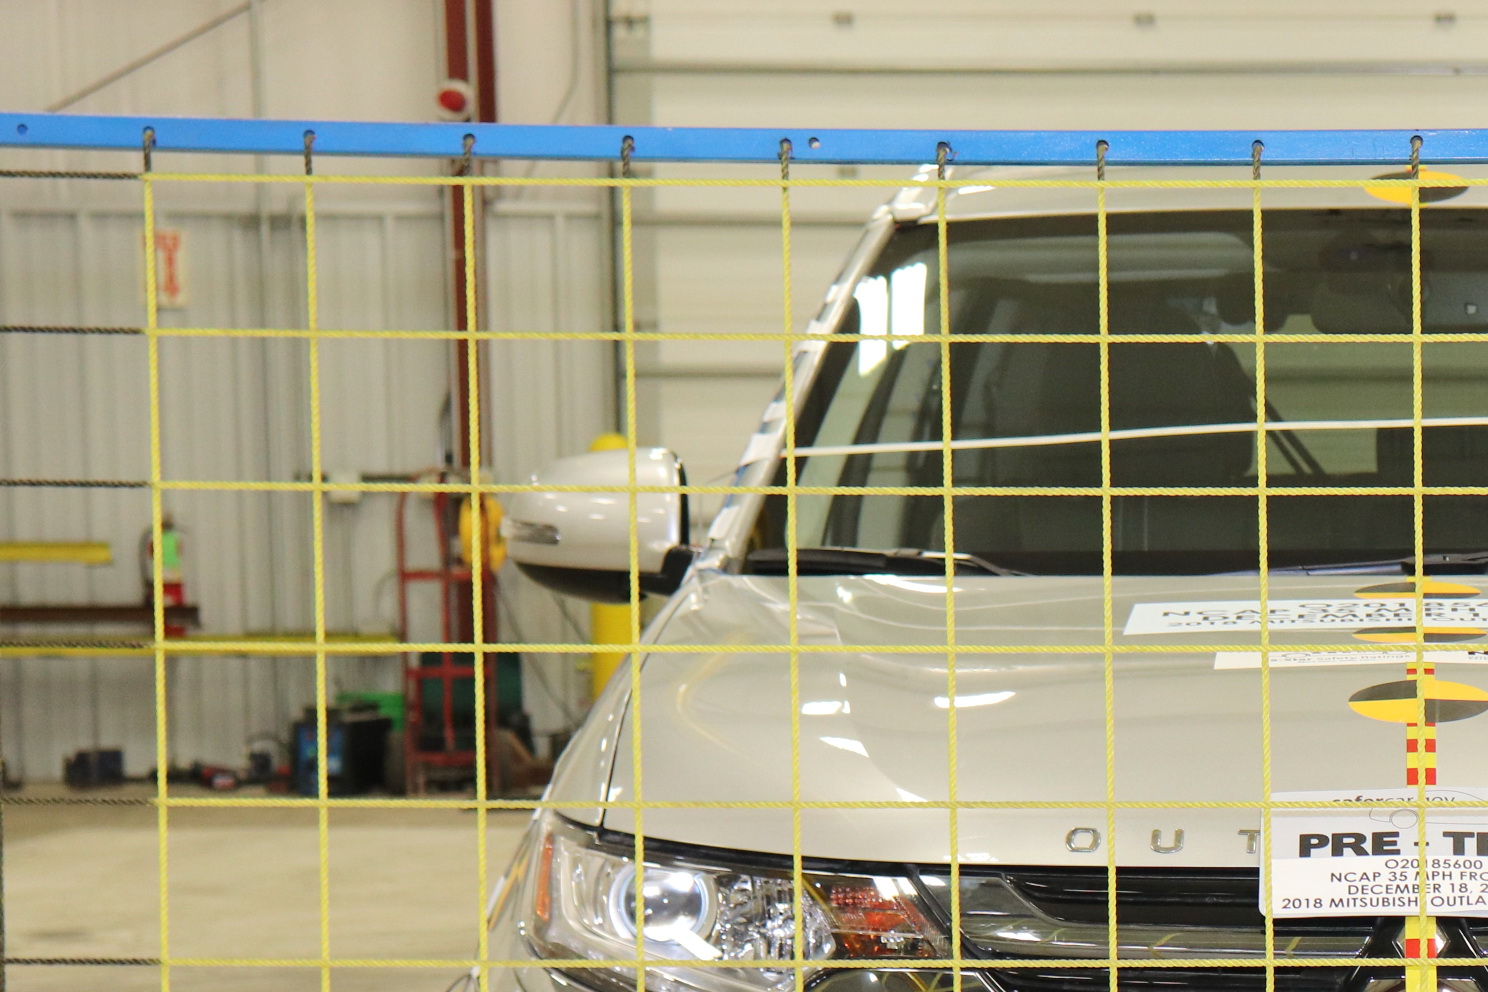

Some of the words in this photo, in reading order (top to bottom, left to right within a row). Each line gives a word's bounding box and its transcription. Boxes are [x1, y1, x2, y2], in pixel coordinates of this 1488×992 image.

[1299, 831, 1401, 859] PRE
[1330, 871, 1382, 883] NCAP
[1388, 871, 1408, 882] 35
[1414, 870, 1453, 882] MPH
[1347, 883, 1442, 896] DECEMBER
[1449, 883, 1474, 895] 18,
[1281, 897, 1324, 909] 2018
[1328, 896, 1420, 909] MITSUBISH
